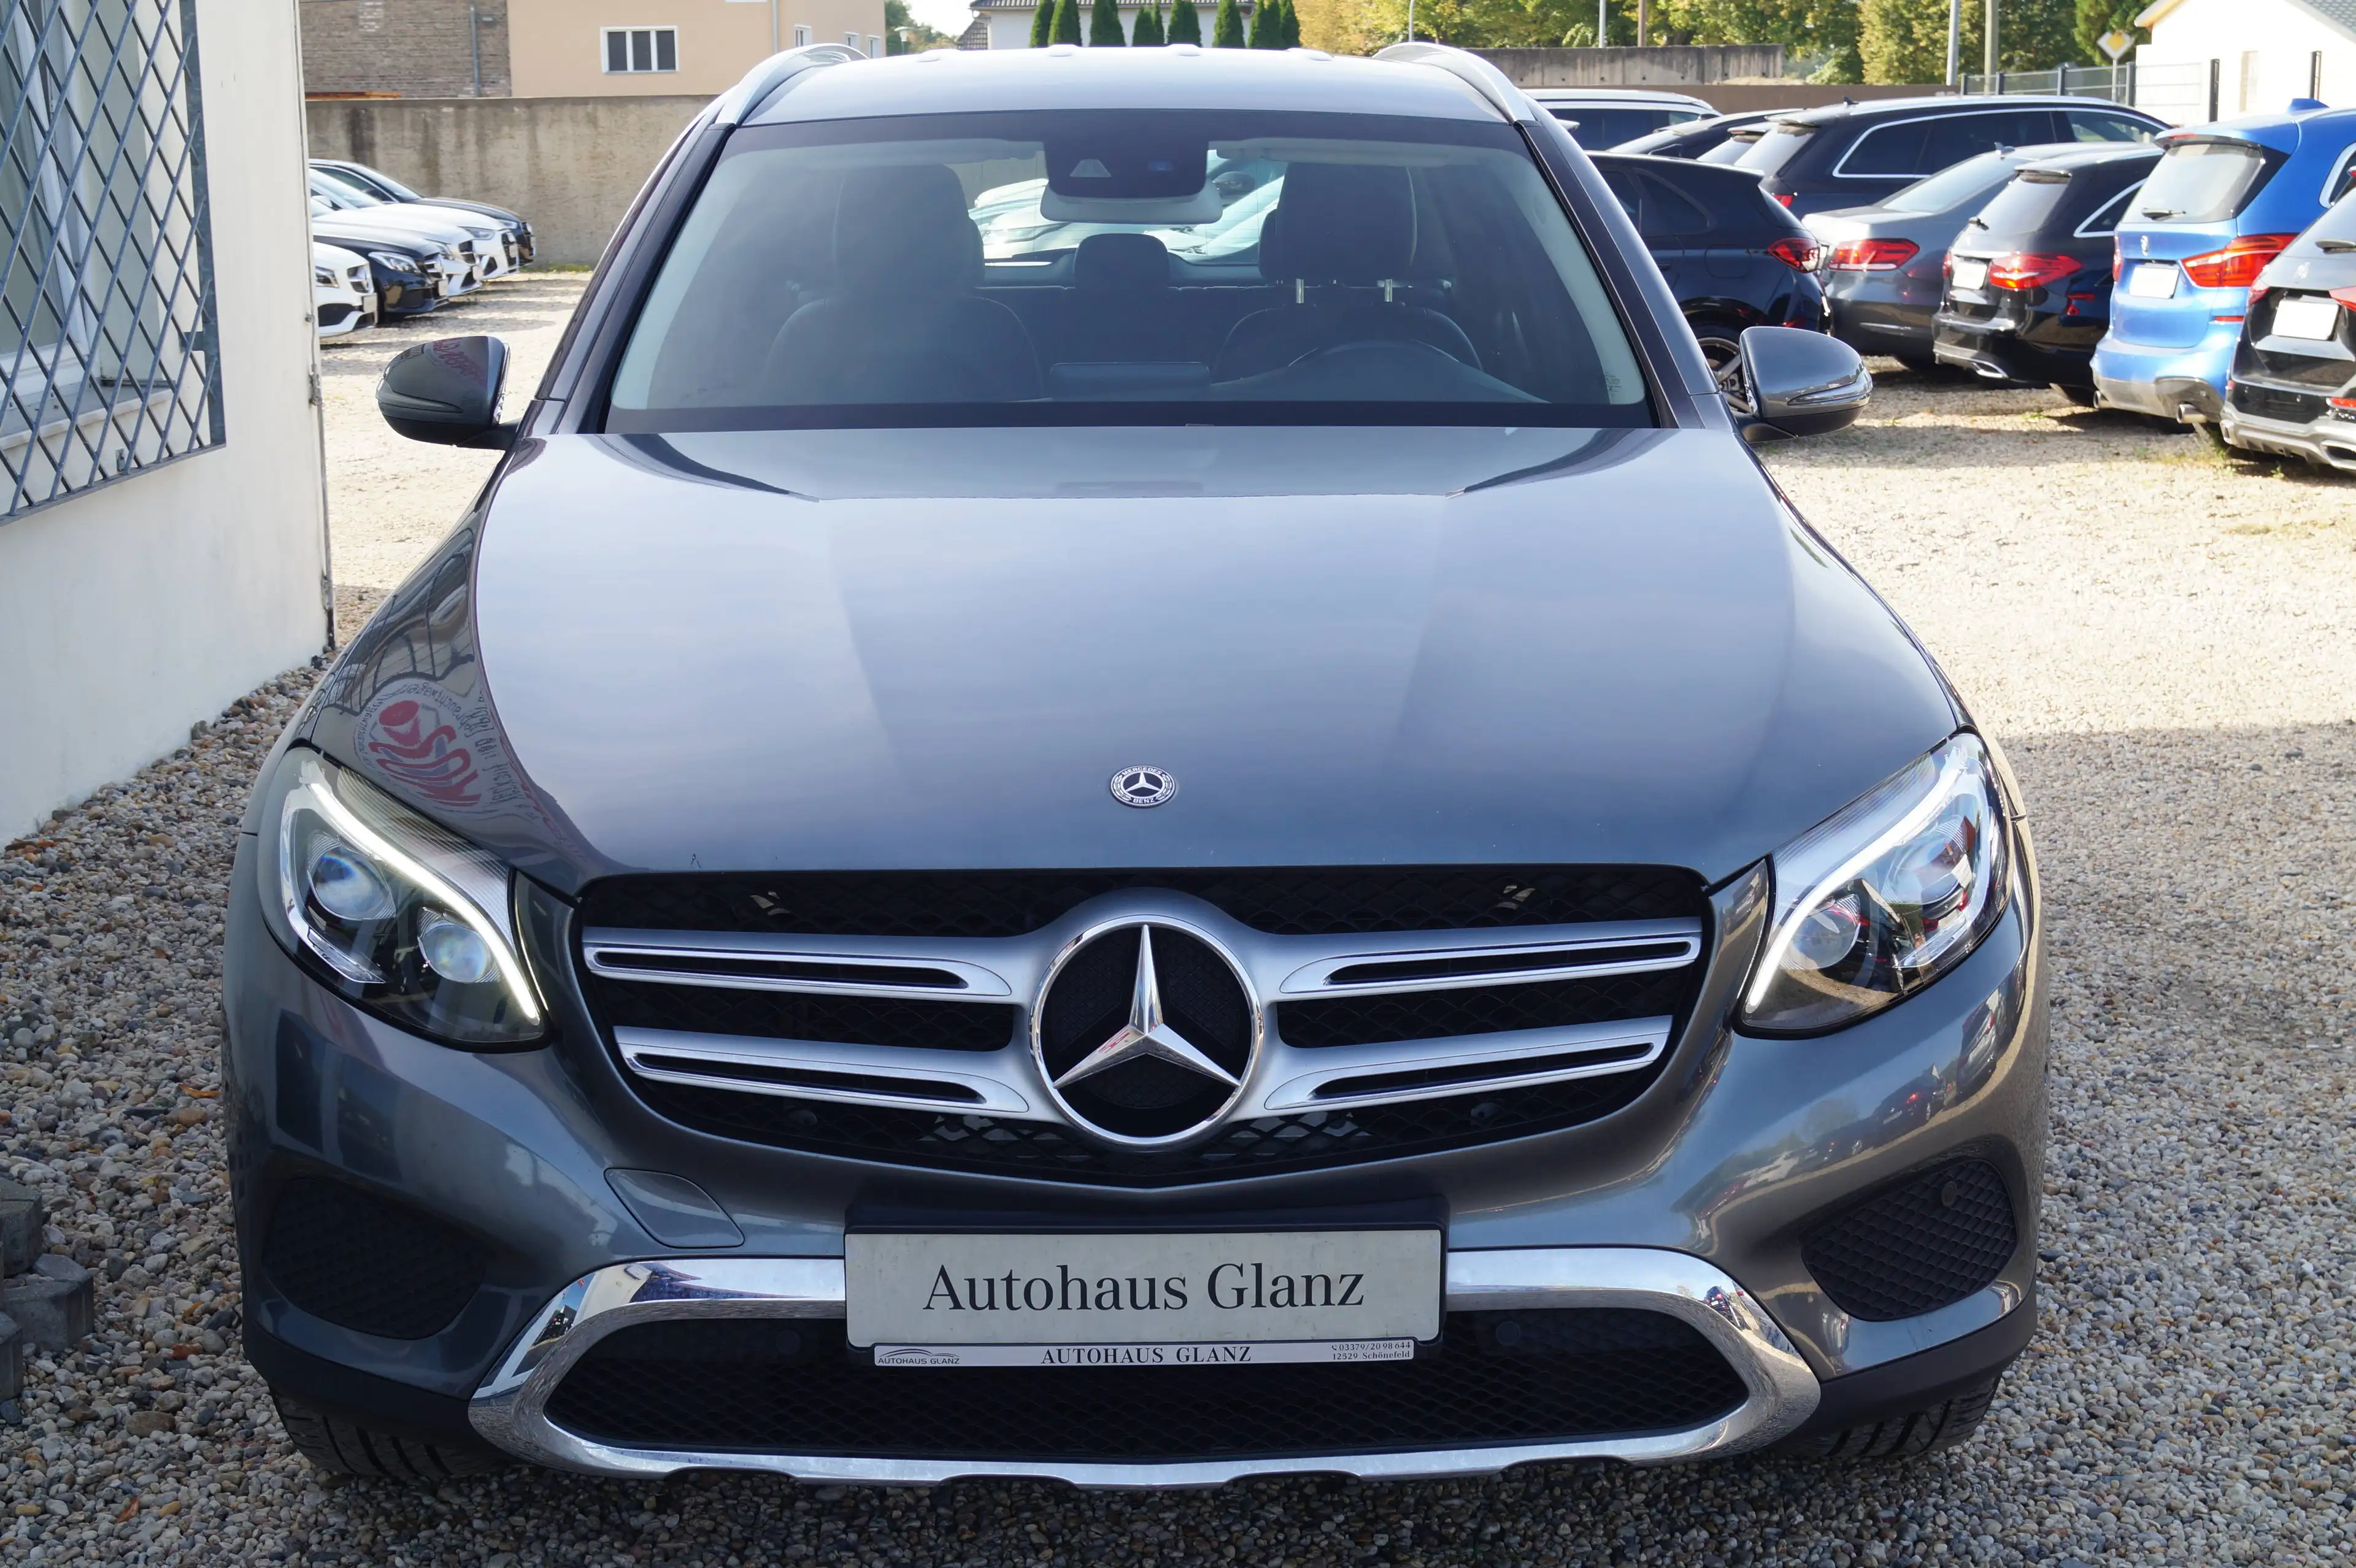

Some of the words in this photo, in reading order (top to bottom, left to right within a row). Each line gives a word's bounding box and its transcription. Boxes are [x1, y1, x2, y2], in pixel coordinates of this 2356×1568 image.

[1122, 767, 1163, 775] MERCEDES
[922, 1264, 1188, 1311] Autohaus
[1207, 1262, 1365, 1310] Glanz
[1041, 1347, 1163, 1364] AUTOHAUS
[1176, 1346, 1252, 1363] GLANZ
[1362, 1350, 1410, 1359] Schönefeld
